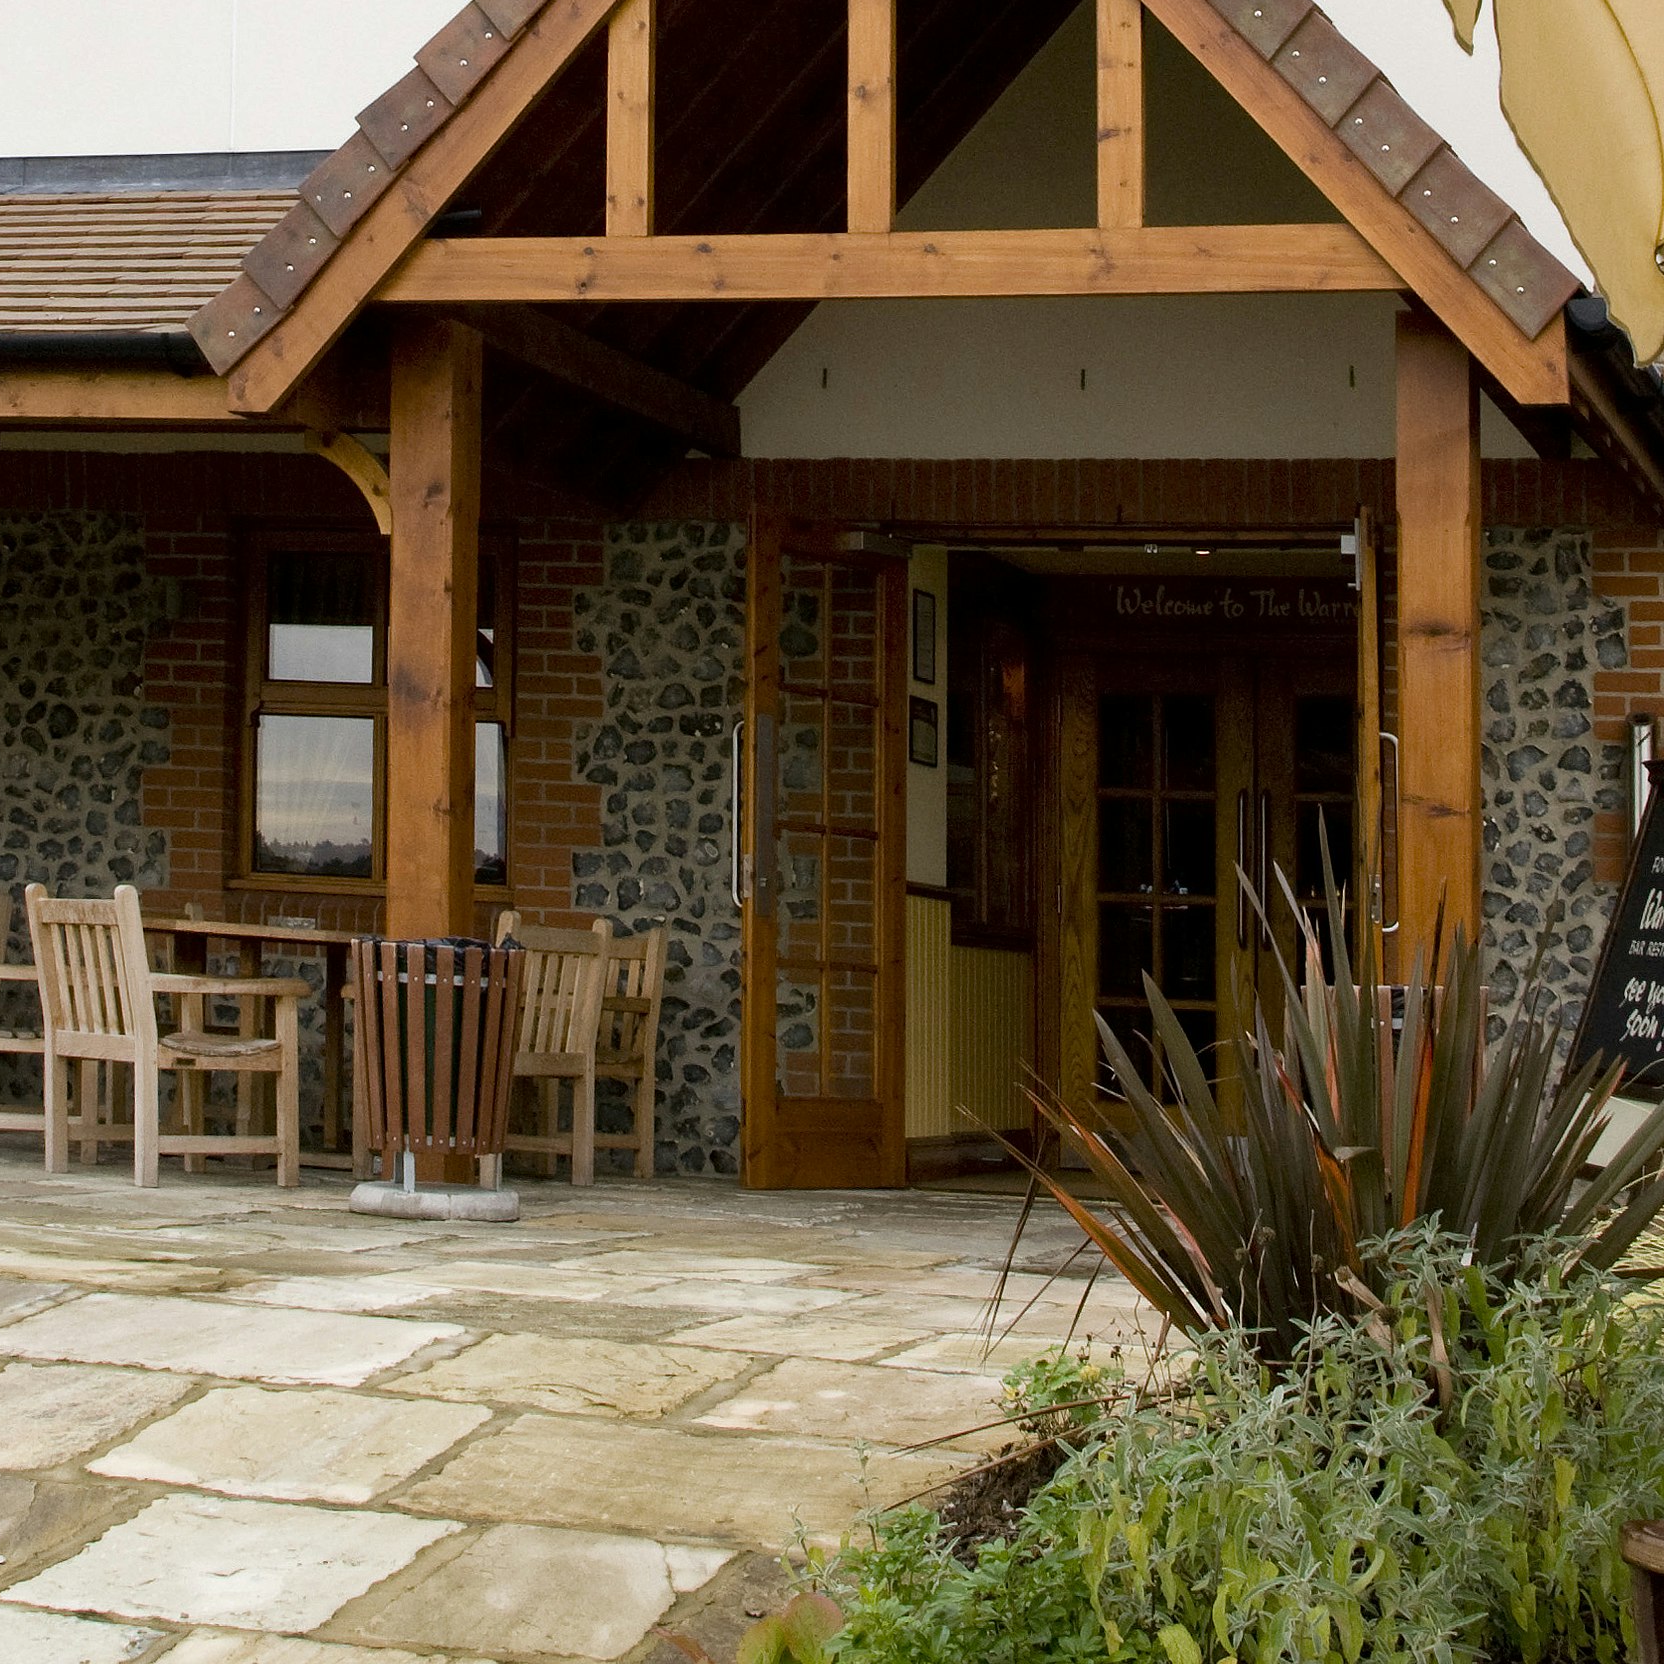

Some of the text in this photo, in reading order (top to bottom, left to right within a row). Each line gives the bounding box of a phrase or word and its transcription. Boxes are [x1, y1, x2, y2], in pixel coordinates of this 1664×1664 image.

[1219, 587, 1245, 619] to
[1249, 587, 1290, 617] The
[1628, 939, 1646, 956] BAR
